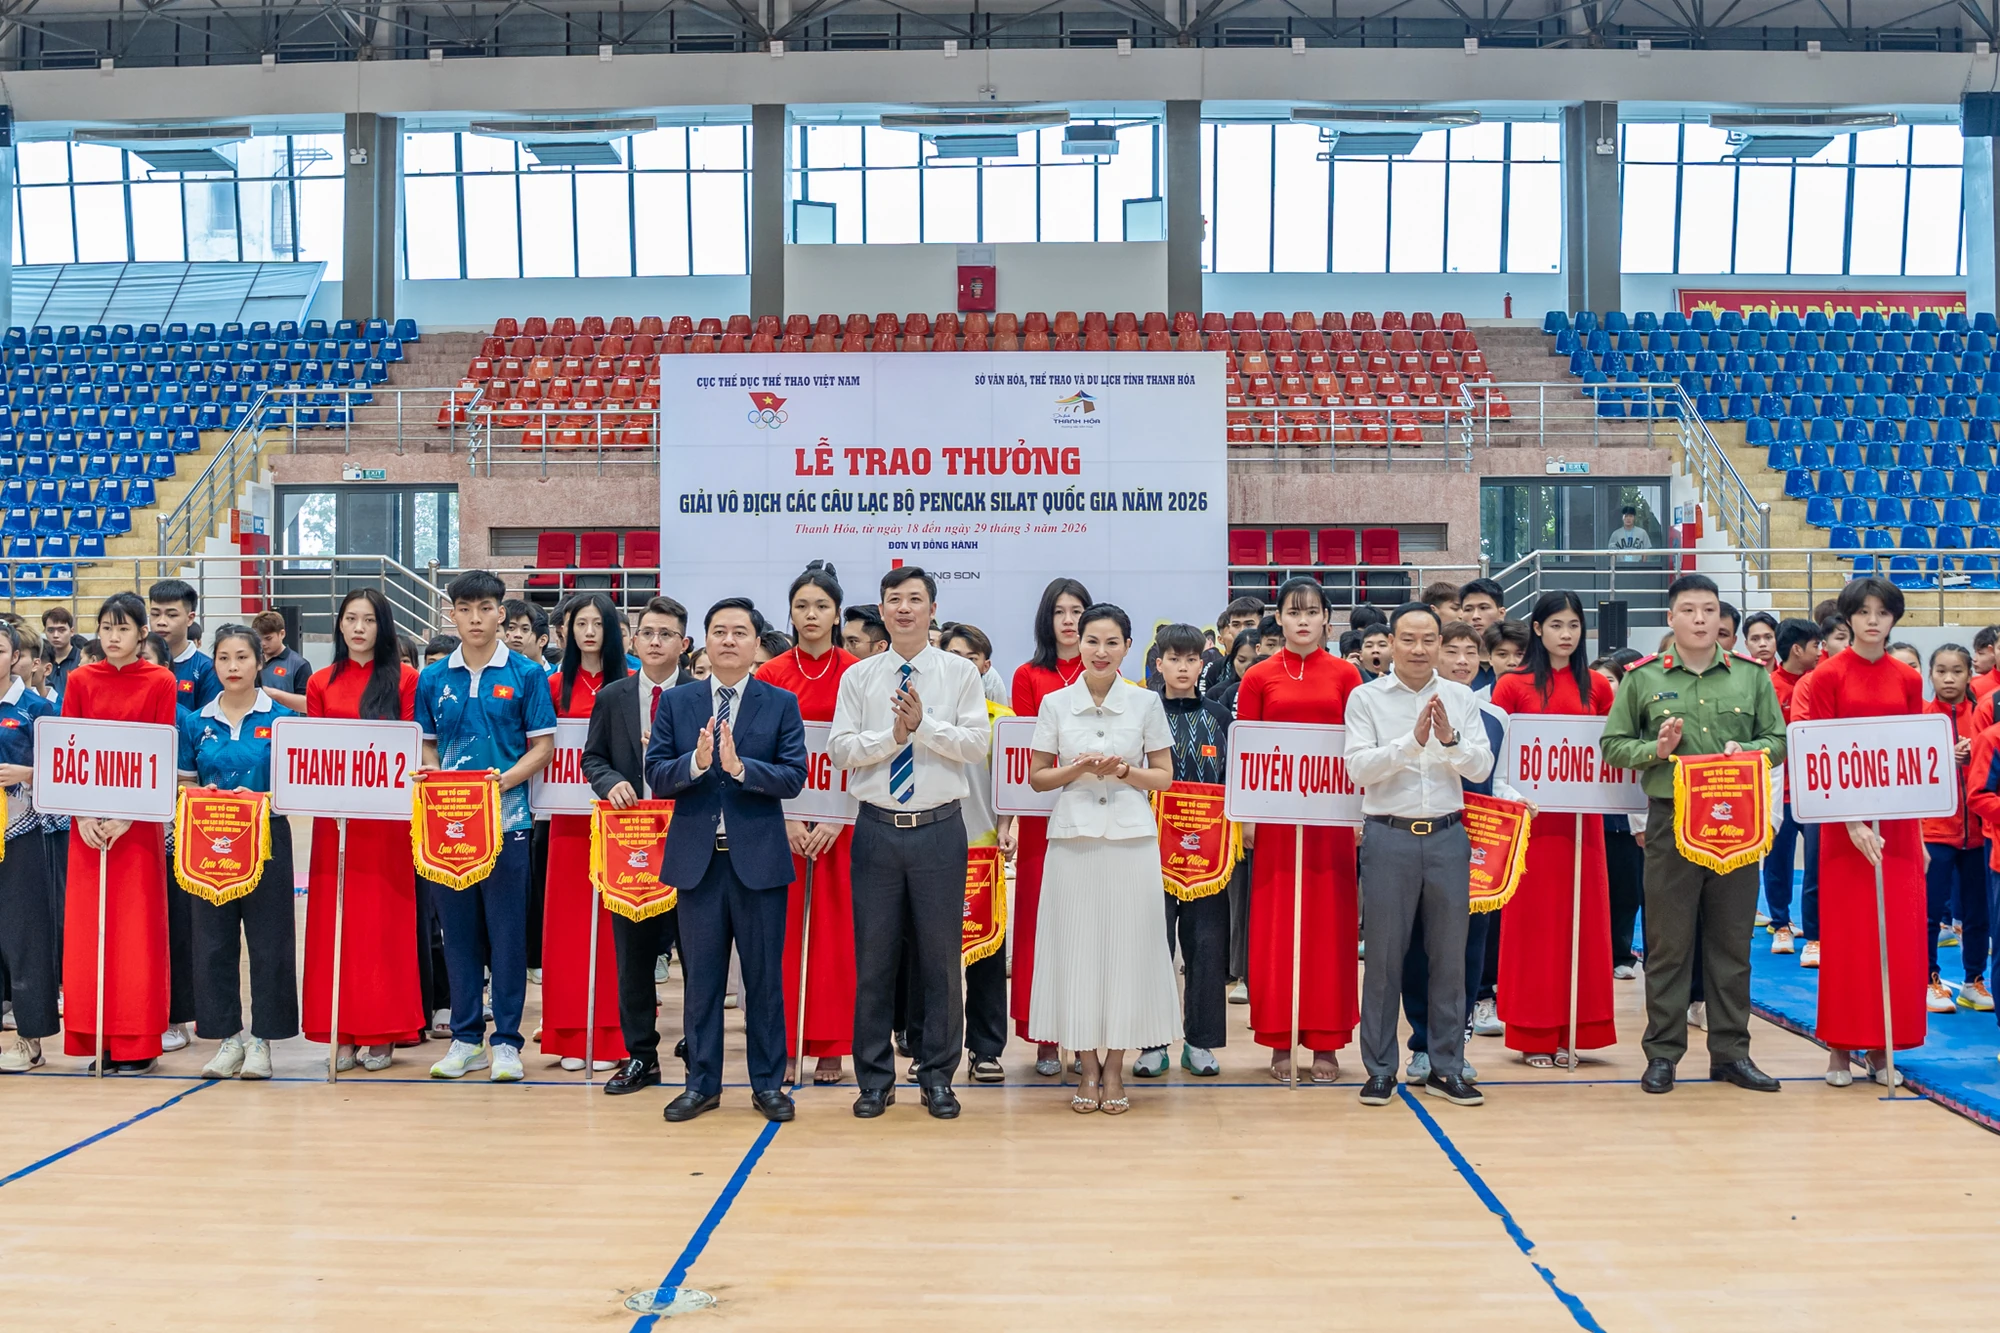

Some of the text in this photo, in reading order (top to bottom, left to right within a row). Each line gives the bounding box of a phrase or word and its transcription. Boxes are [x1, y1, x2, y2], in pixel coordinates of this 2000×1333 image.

[697, 377, 715, 389] CỤC
[718, 374, 737, 386] THỂ
[740, 377, 759, 389] DỤC
[762, 373, 781, 386] THỂ
[784, 376, 810, 386] THAO
[814, 374, 835, 388] VIỆT
[838, 376, 860, 386] NAM
[988, 373, 1004, 385] VĂN
[1049, 375, 1072, 385] THAO
[1074, 372, 1085, 385] VÀ
[1087, 375, 1098, 385] DU
[1100, 375, 1121, 387] LỊCH
[1146, 374, 1176, 384] THANH
[1178, 372, 1195, 384] HÓA
[794, 437, 1081, 476] LỄ TRAO THƯỞNG
[680, 485, 1208, 516] GIẢI VÔ ĐỊCH CÁC CÂU LẠC BỘ PENCAK SILAT QUỐC GIA NĂM 2026
[794, 520, 1087, 536] Thanh Hóa, từ ngày 18 đến ngày 29 tháng 3 năm 2026
[888, 538, 978, 551] ĐƠN VỊ ĐỒNG HÀNH
[924, 572, 951, 580] ONG
[53, 734, 156, 789] BẮC NINH 1
[288, 742, 406, 788] THANH HÓA 2
[1240, 745, 1354, 798] TUYÊN QUANG
[1520, 736, 1542, 790] BỘ
[1548, 738, 1594, 782] CÔNG
[1806, 742, 1940, 799] BỘ CÔNG AN 2
